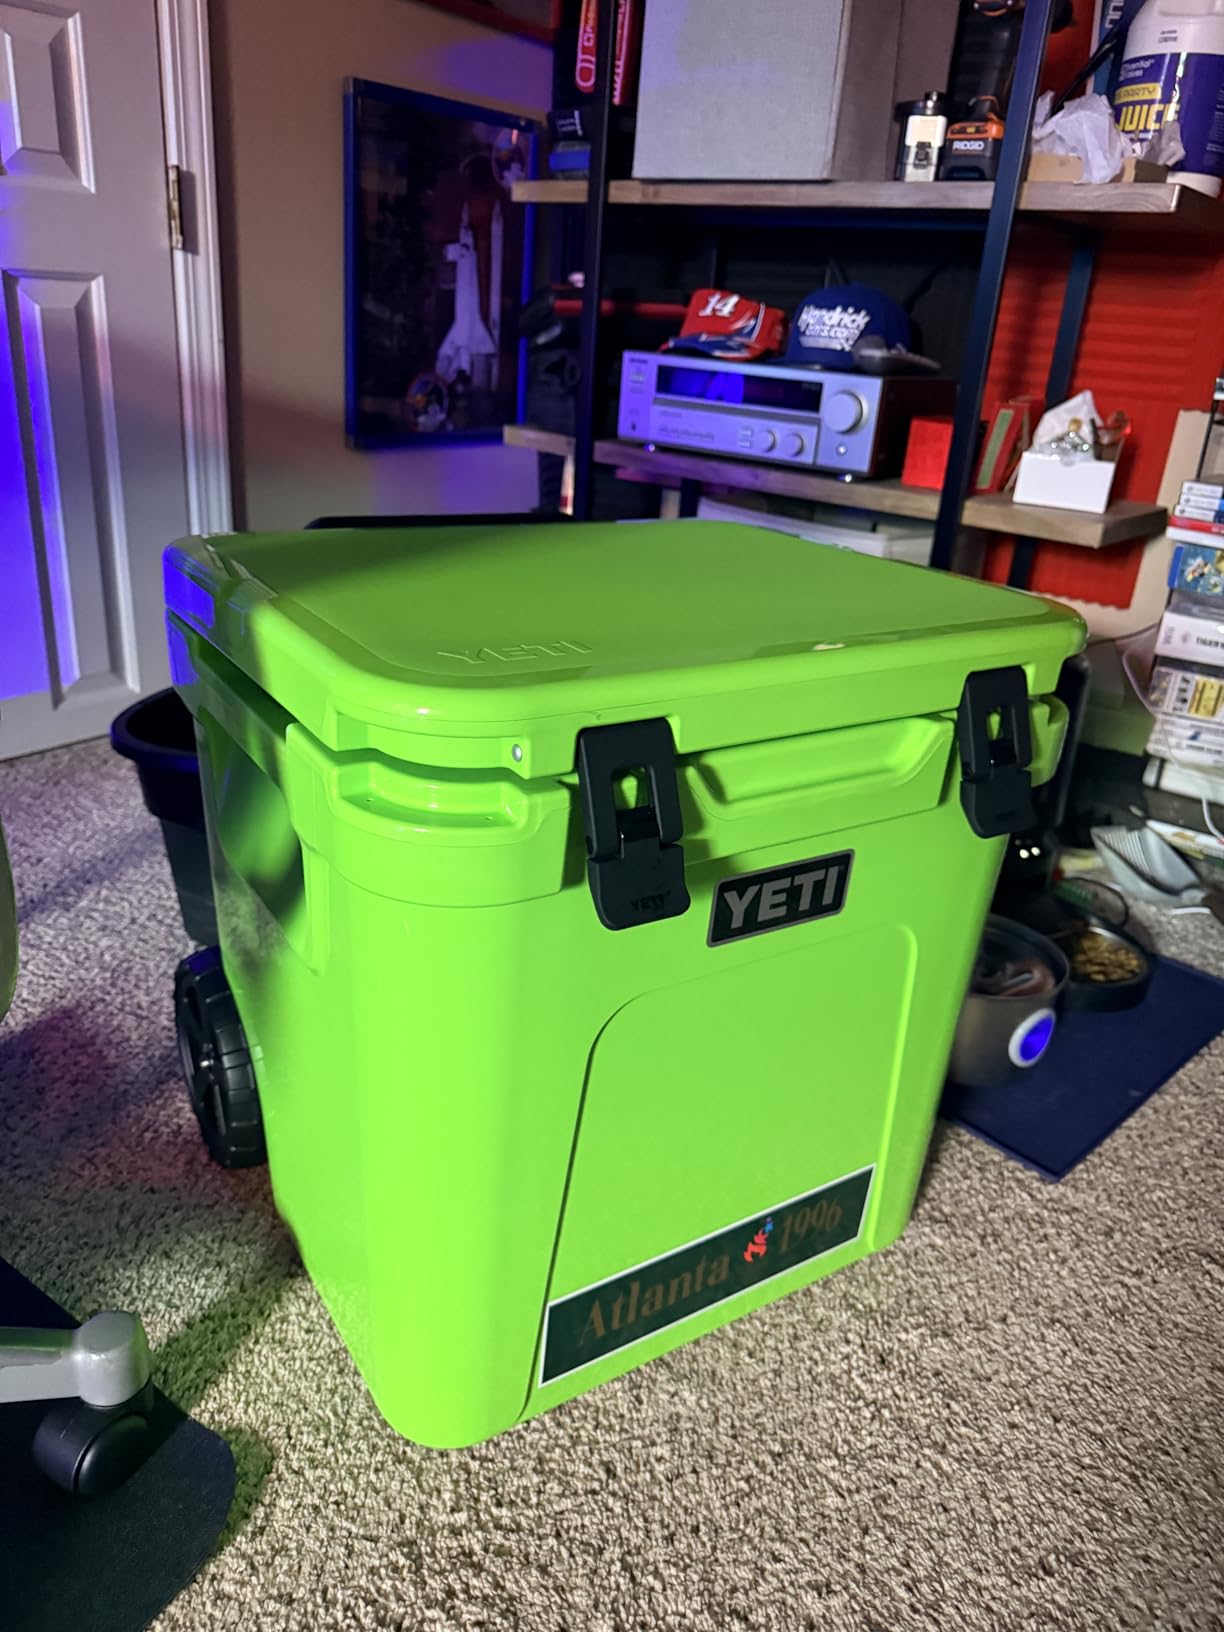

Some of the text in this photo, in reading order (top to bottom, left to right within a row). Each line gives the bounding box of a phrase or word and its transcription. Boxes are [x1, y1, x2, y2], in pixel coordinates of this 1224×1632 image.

[698, 293, 740, 318] 14
[797, 304, 871, 332] Hendrick
[437, 641, 593, 664] YETI
[629, 893, 665, 912] YETI
[722, 865, 840, 929] YETI
[578, 1198, 842, 1347] Atlanta 1996
